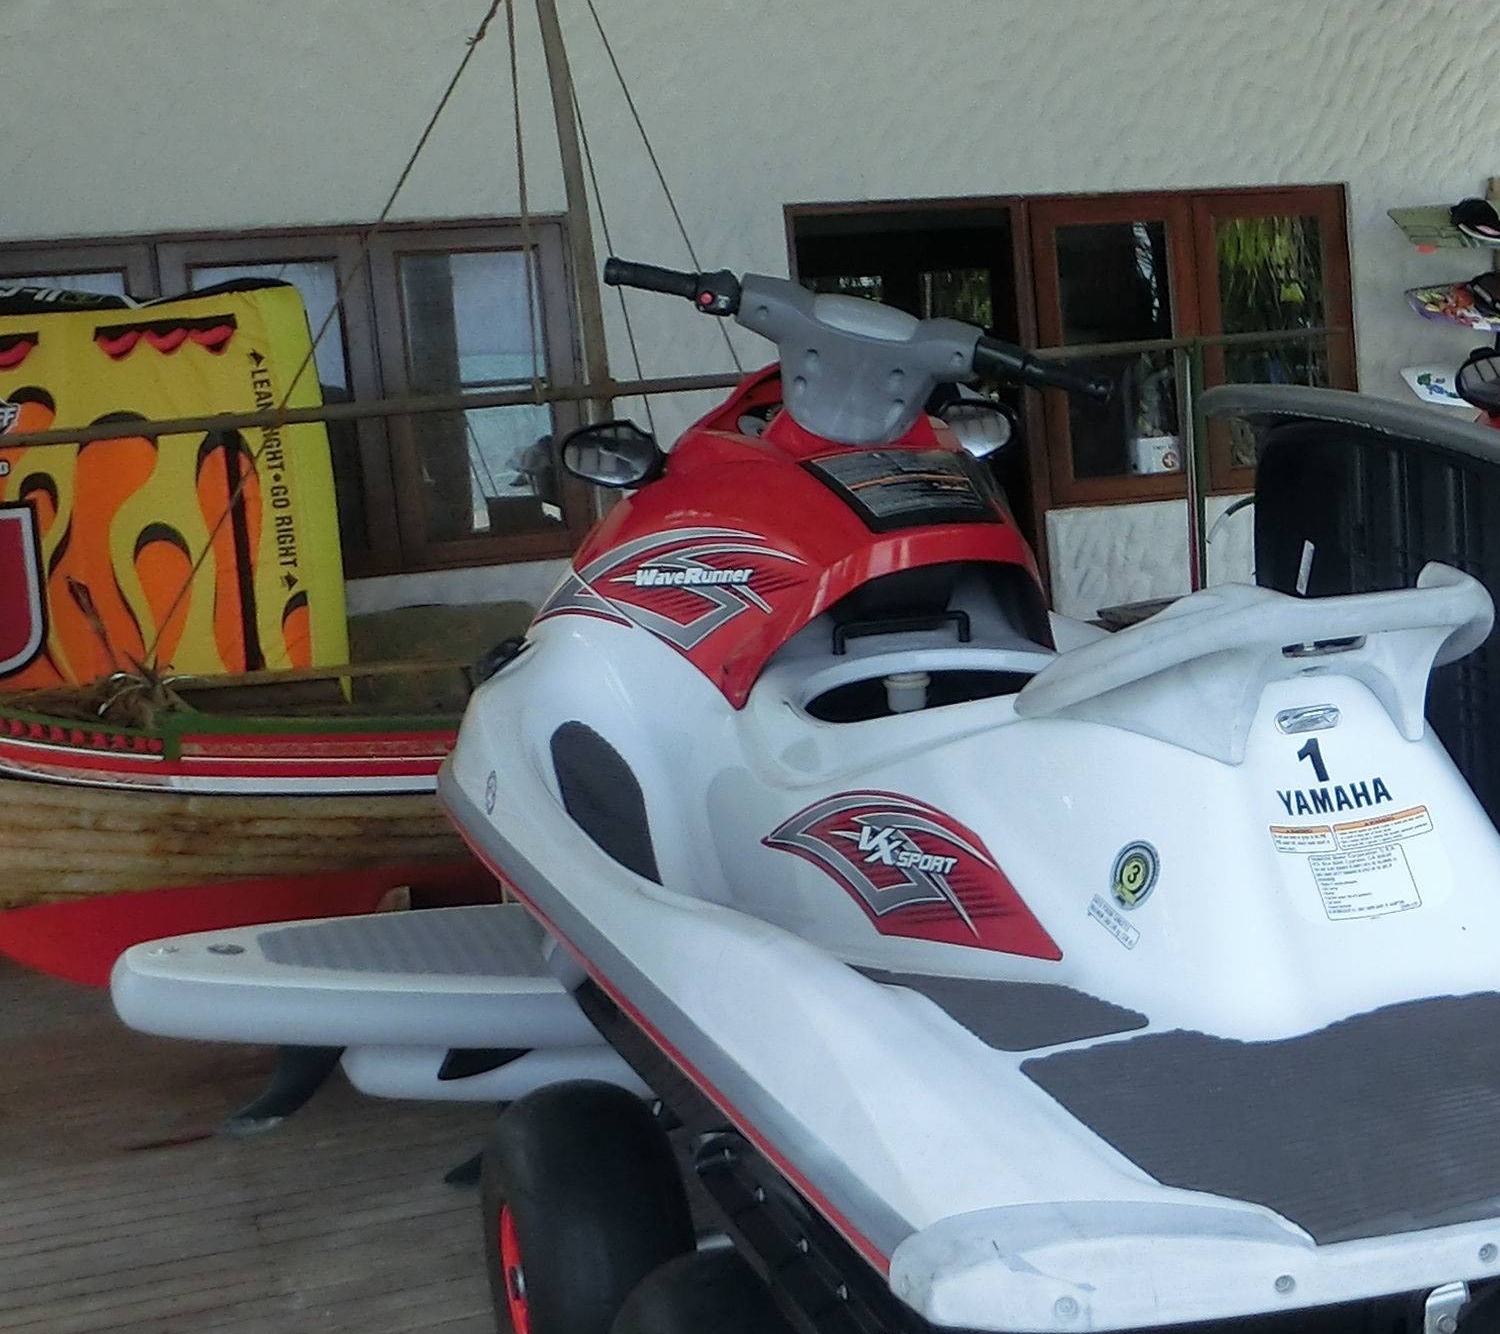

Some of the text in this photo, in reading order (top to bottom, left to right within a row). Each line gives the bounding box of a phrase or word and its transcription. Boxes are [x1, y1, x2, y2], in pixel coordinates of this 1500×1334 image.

[270, 485, 290, 509] GO
[275, 516, 298, 568] RIGHT
[634, 567, 754, 586] WaveRunner
[1297, 737, 1330, 783] 1
[1276, 777, 1394, 816] YAMAHA
[858, 826, 958, 874] VX SPORT
[1127, 864, 1141, 884] 3
